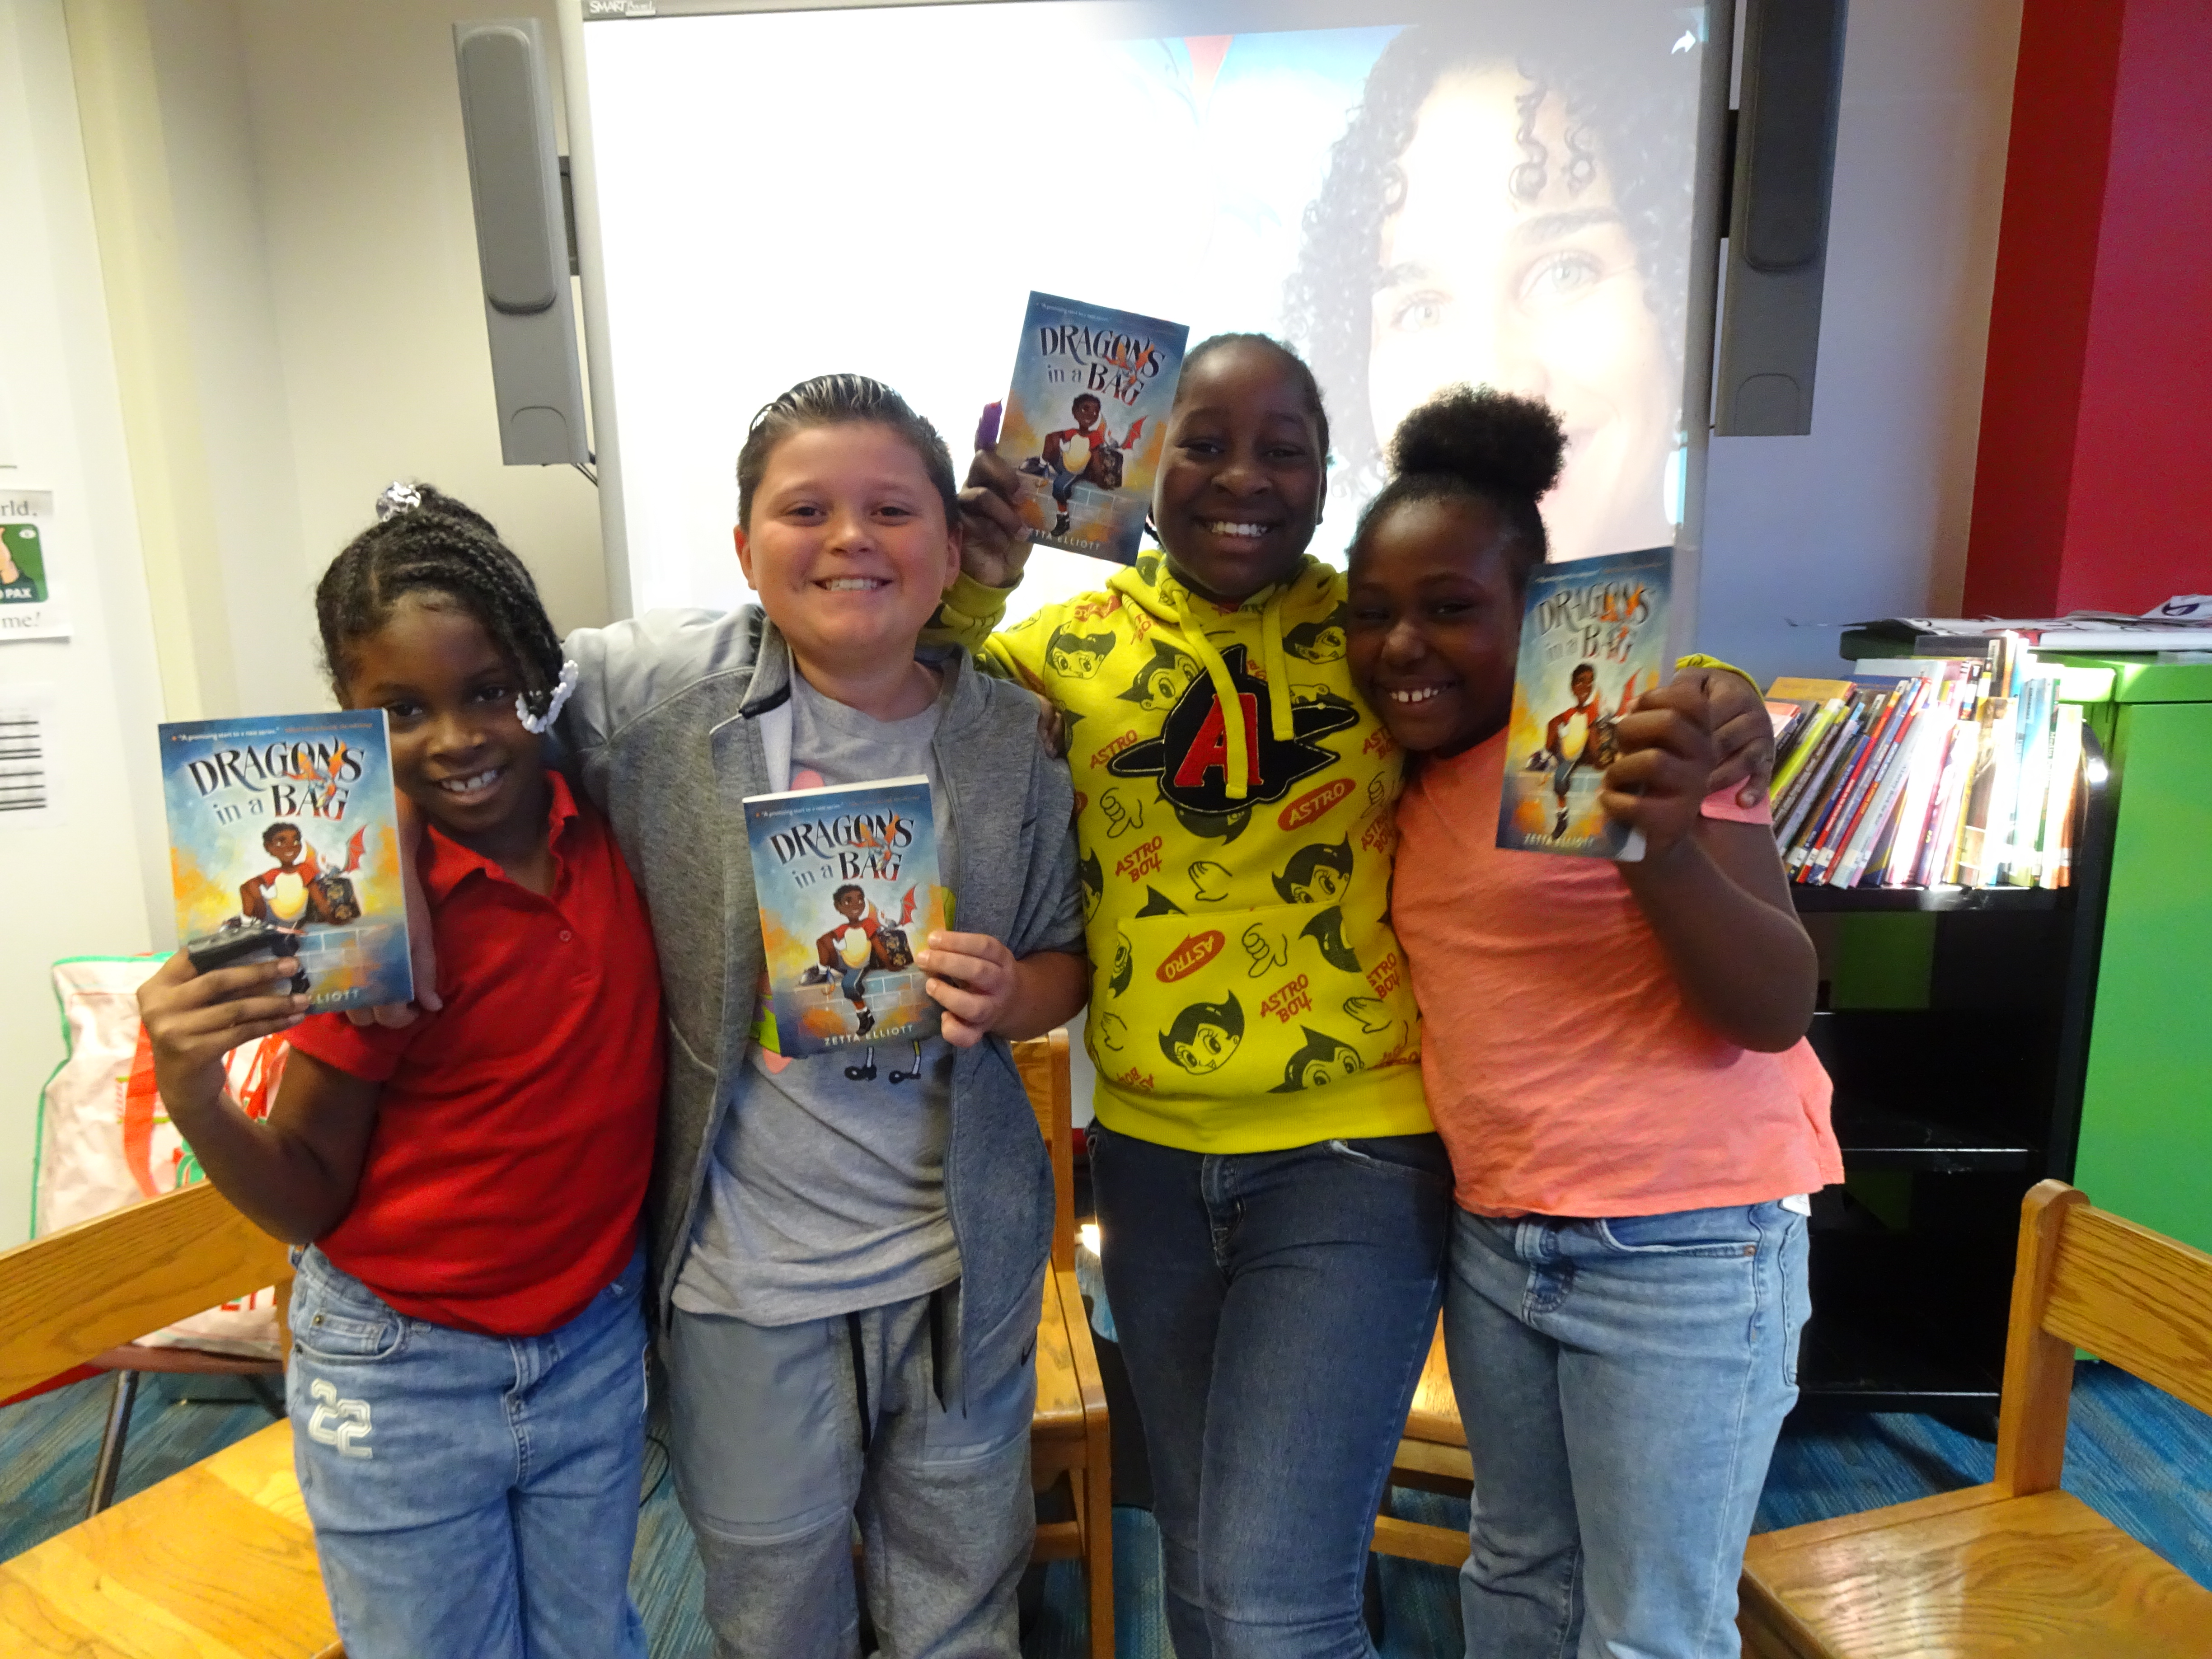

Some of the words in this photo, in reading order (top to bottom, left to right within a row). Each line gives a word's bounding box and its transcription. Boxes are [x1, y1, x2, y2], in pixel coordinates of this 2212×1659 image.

[590, 0, 626, 14] SMART
[1040, 324, 1165, 379] DRAGONS
[1047, 364, 1065, 383] in
[1071, 370, 1082, 383] a
[1087, 362, 1144, 407] BAG
[189, 736, 365, 797] DRAGONS
[1090, 728, 1139, 770] ASTRO
[214, 803, 242, 826] in
[250, 797, 264, 815] a
[271, 783, 350, 821] BAG
[1289, 781, 1346, 826] ASTRO
[770, 808, 914, 865] DRAGONS
[1115, 835, 1163, 877] ASTRO
[792, 867, 815, 890] in
[821, 864, 834, 879] a
[839, 851, 903, 882] BAG
[1129, 853, 1163, 883] BOY
[1164, 935, 1215, 980] ASTRO
[1260, 974, 1309, 1018] ASTRO
[1276, 991, 1312, 1024] BOY
[824, 1032, 861, 1047] ZETTA
[866, 1024, 913, 1040] ELLIOTT
[308, 1378, 373, 1459] 22
